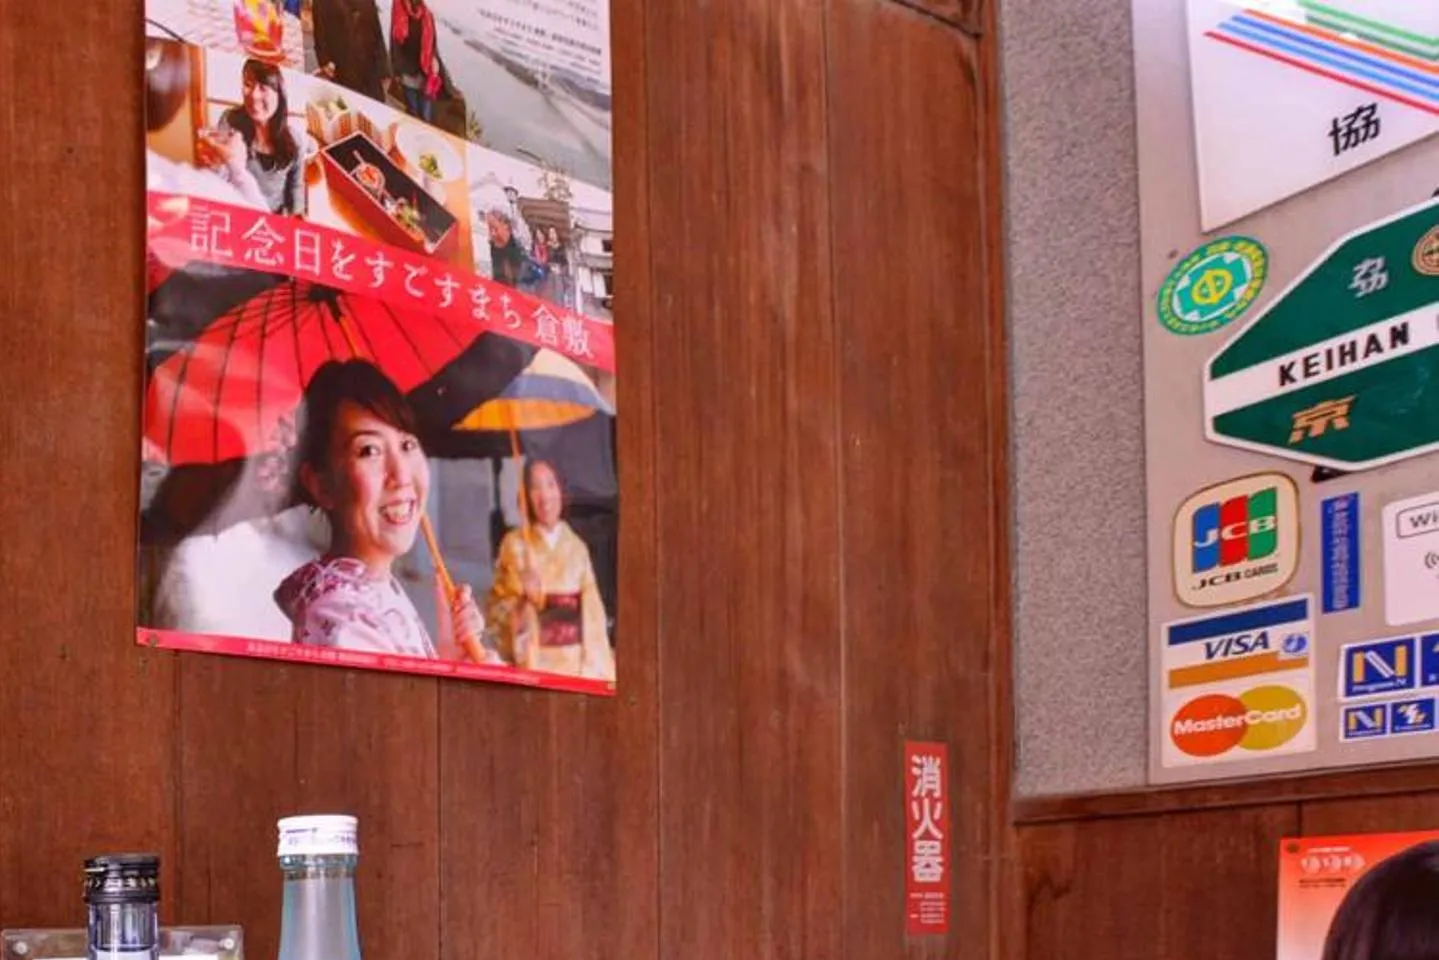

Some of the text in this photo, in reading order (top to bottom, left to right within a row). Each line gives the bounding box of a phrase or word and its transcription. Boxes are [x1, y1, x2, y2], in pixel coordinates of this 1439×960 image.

[1278, 322, 1410, 387] KEIHAN
[1193, 515, 1277, 549] JCB
[1191, 572, 1241, 590] JCB
[1205, 631, 1270, 660] VISA
[1174, 704, 1302, 735] MasterCard
[912, 755, 944, 882] 消火器
